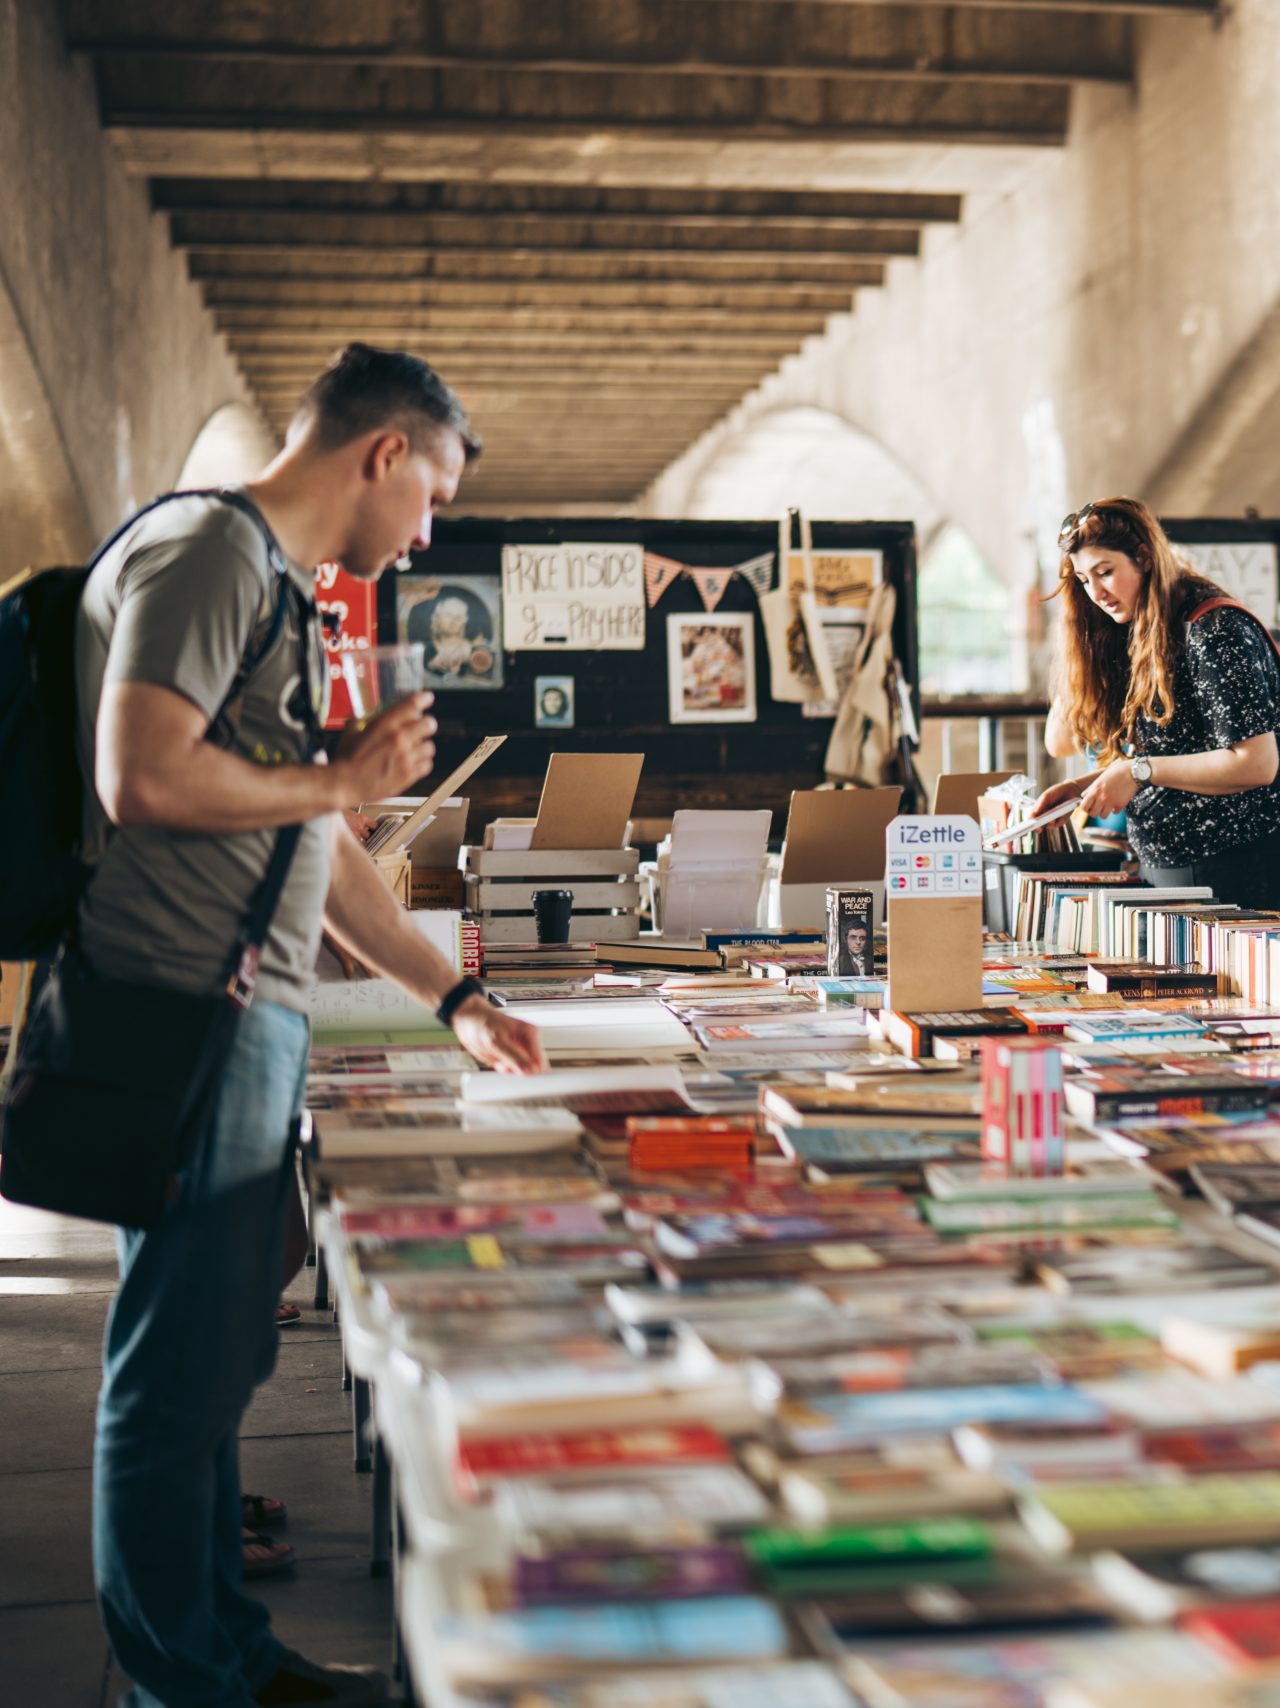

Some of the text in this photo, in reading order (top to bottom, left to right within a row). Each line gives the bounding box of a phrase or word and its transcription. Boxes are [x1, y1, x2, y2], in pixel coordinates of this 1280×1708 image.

[900, 825, 965, 844] iZettle
[841, 896, 872, 904] WAR AND
[845, 902, 868, 910] PEACE
[461, 928, 480, 978] ROBER
[1157, 988, 1175, 996] PETER
[1176, 987, 1205, 996] ACKROYD
